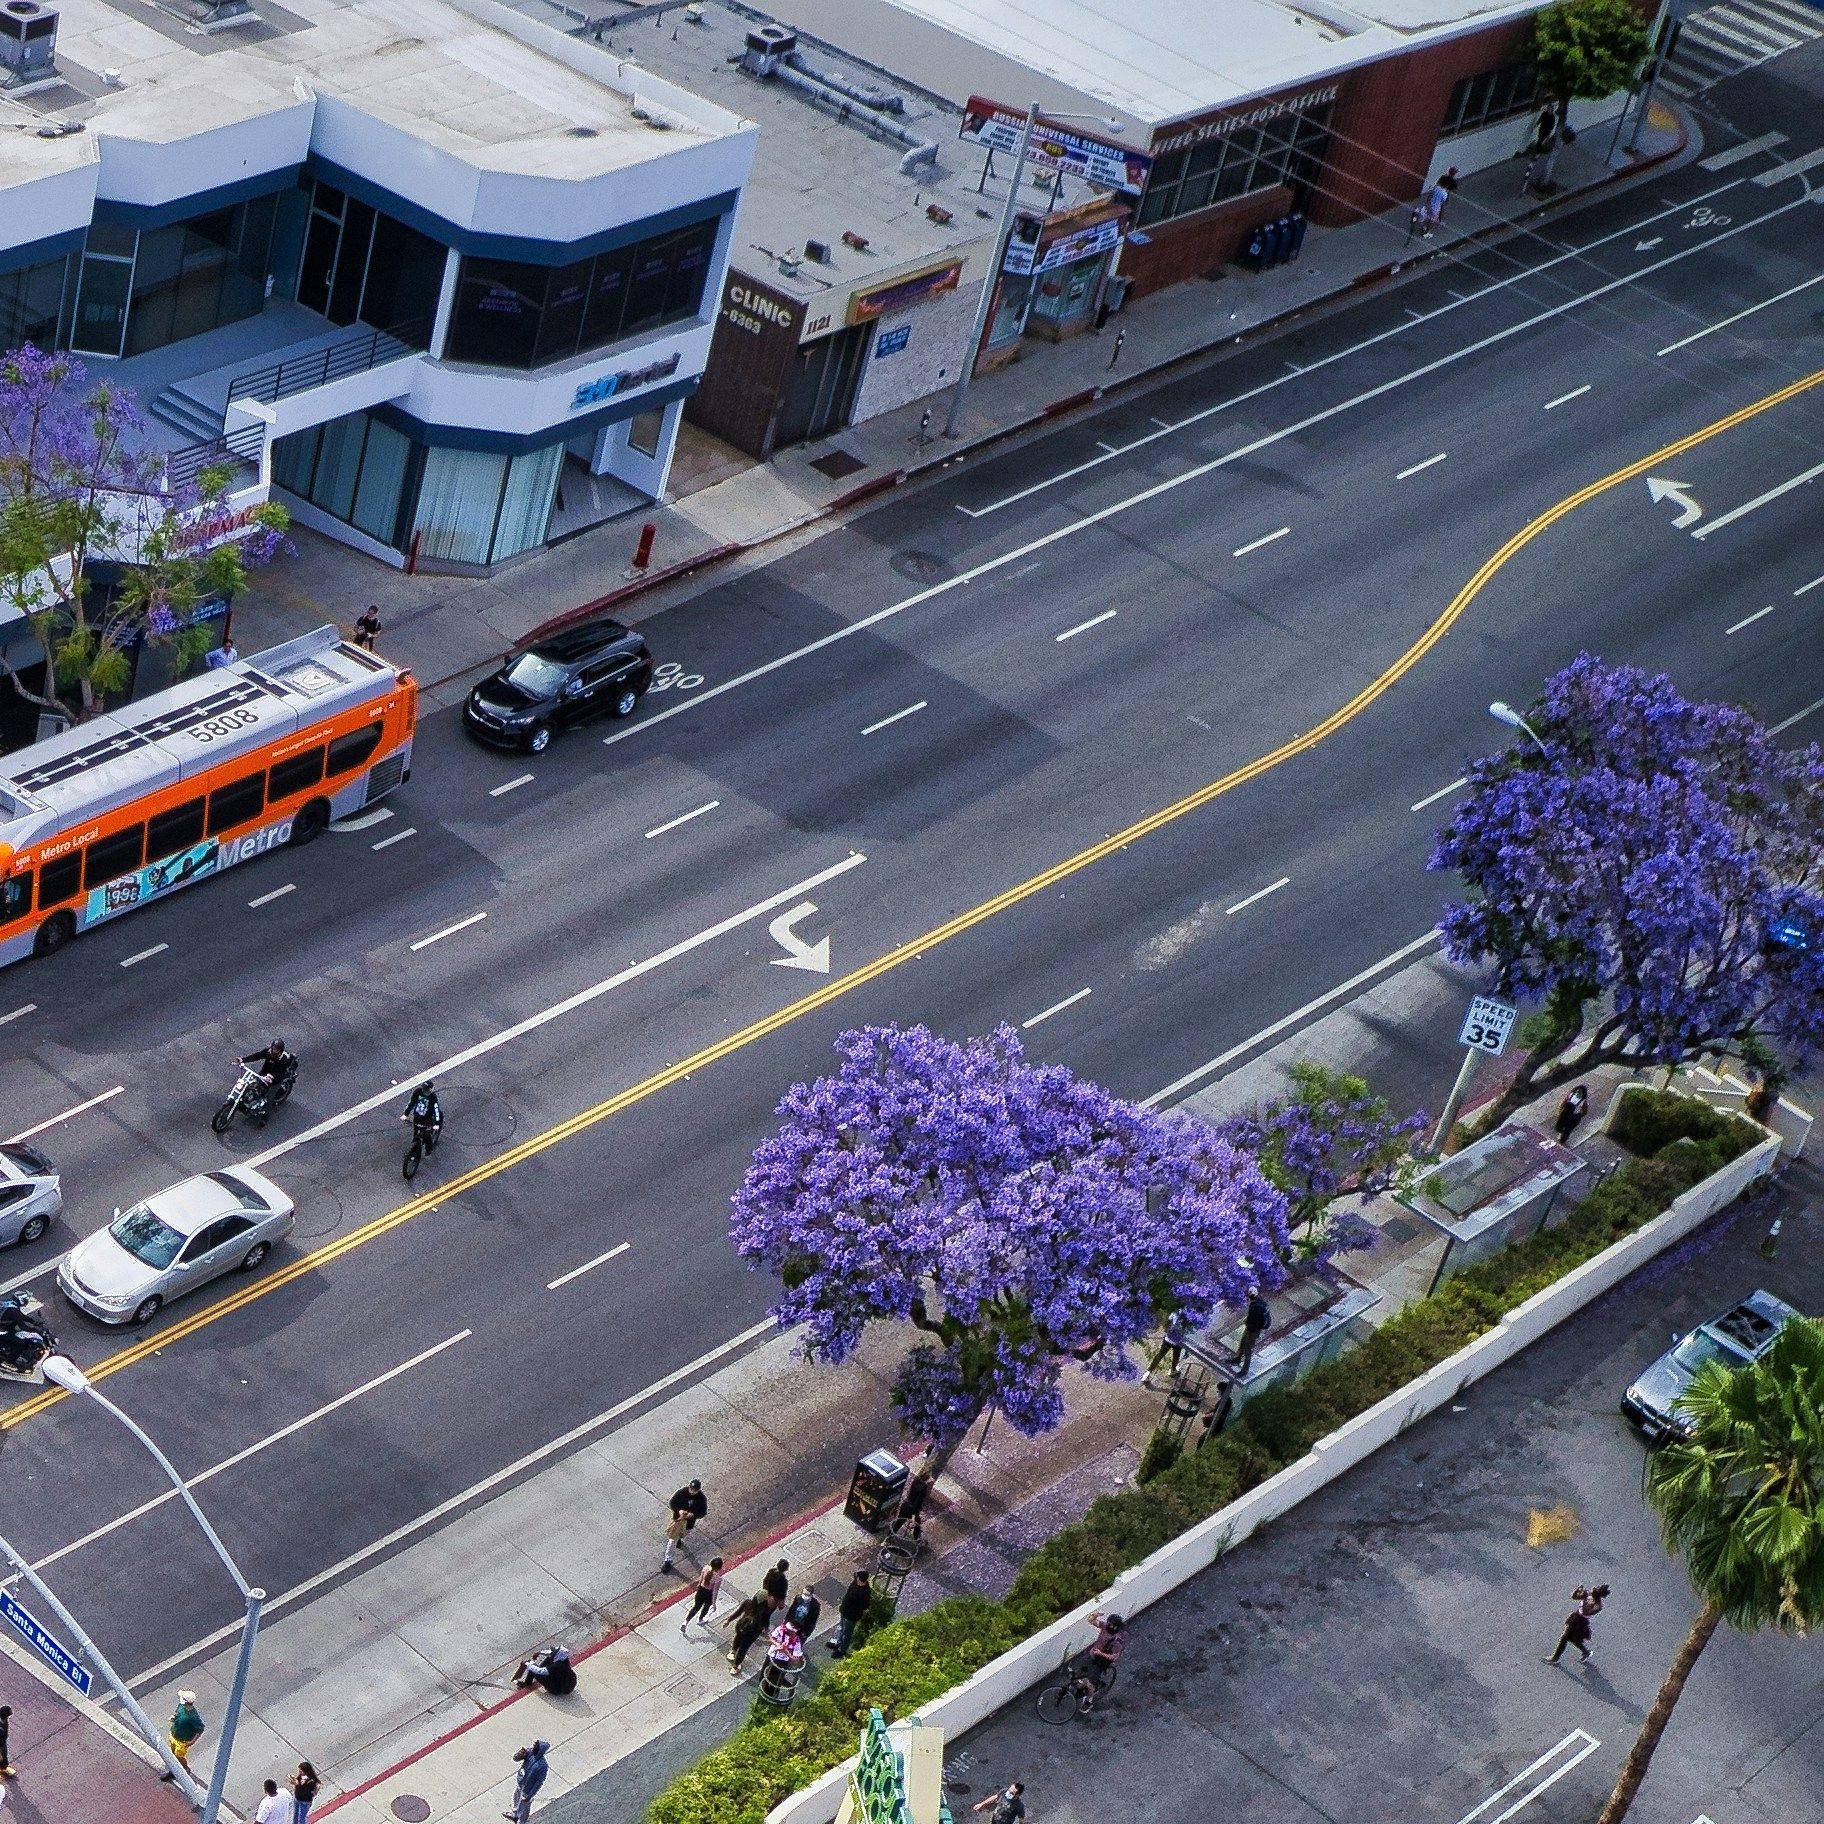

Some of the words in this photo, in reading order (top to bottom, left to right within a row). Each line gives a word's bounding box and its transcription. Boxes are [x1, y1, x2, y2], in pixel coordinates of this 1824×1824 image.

[1293, 85, 1338, 113] OFFICE
[1083, 137, 1128, 161] SERVICES
[730, 285, 792, 328] CLINIC
[807, 315, 830, 335] 1121
[188, 707, 260, 744] 5808
[41, 837, 72, 860] Metro
[74, 827, 99, 849] Local
[218, 822, 292, 870] Metro
[1473, 1012, 1509, 1031] LIMIT
[1474, 998, 1514, 1021] SPEED
[1466, 1027, 1501, 1051] 35
[6, 1602, 34, 1636] Santa
[36, 1631, 69, 1671] Monica
[71, 1666, 83, 1684] Bl
